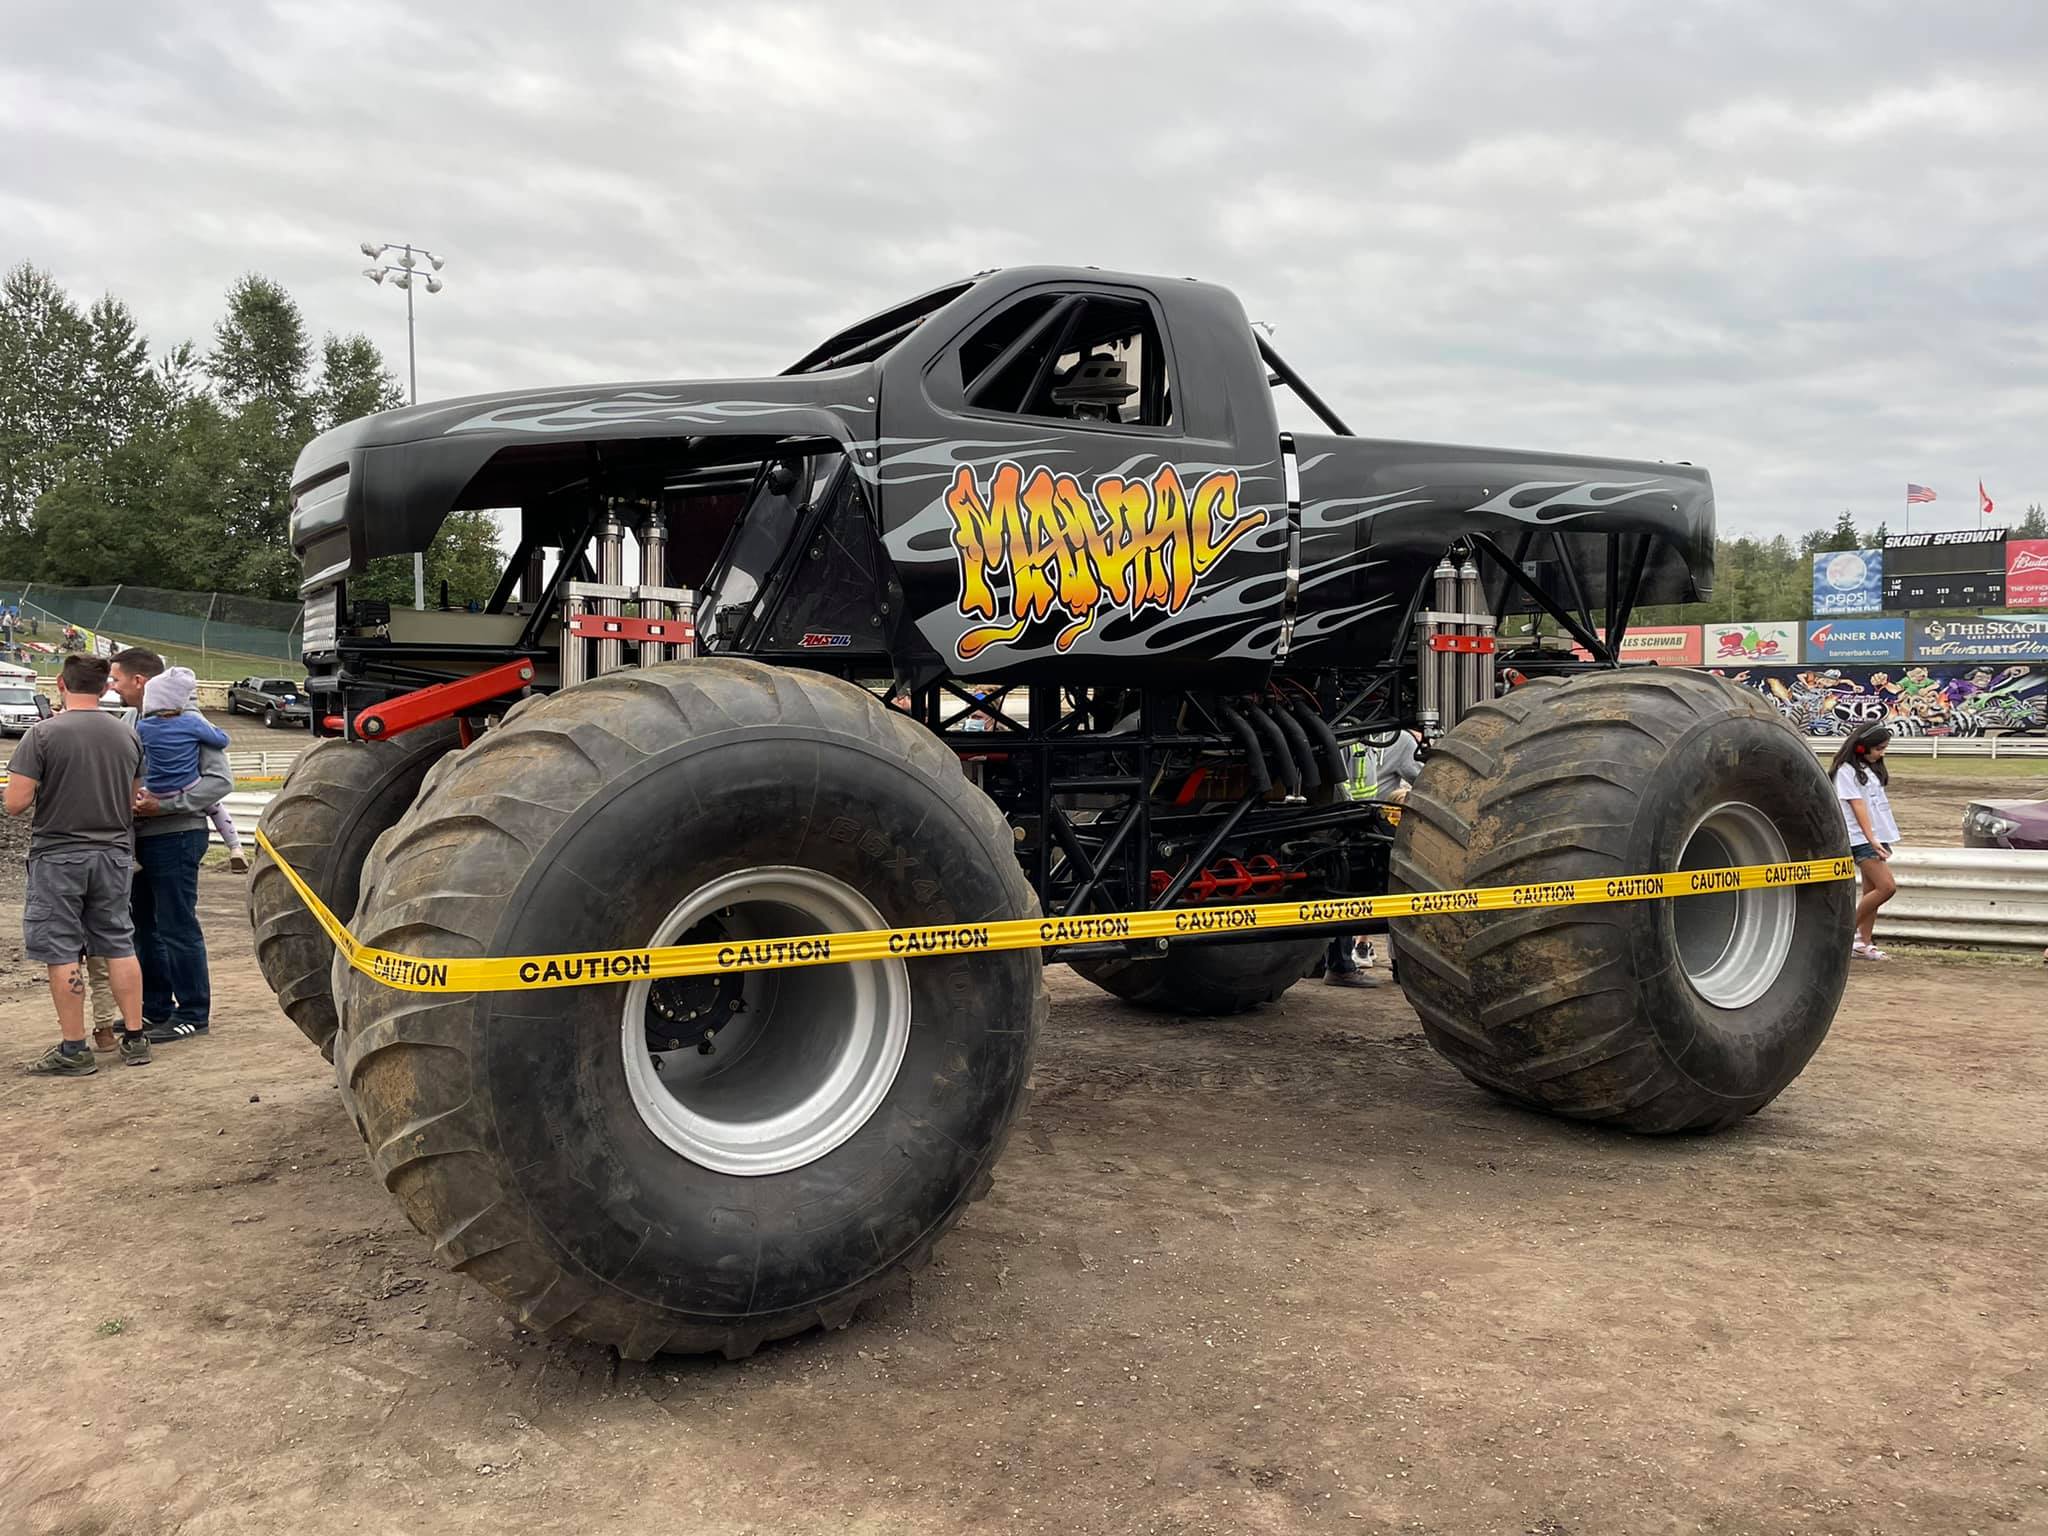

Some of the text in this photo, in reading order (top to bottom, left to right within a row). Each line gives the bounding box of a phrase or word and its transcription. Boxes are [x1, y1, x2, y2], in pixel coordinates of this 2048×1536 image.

[1884, 530, 2005, 548] SKAGIT SPEEDWAY
[944, 461, 1268, 661] MANIAC
[1826, 590, 1867, 606] pepsi
[1819, 630, 1902, 641] BANNER BANK
[1946, 623, 1985, 635] THE
[798, 633, 851, 648] AMSOIL
[1623, 637, 1682, 648] LES SCHWAB
[1829, 649, 1889, 657] bannerbank.com
[1919, 647, 1943, 656] THE
[1968, 645, 2017, 655] STARTS
[374, 955, 447, 986] CAUTION
[520, 955, 650, 983] CAUTION
[718, 940, 830, 967] CAUTION
[889, 928, 988, 952] CAUTION
[1040, 918, 1128, 941] CAUTION
[1176, 910, 1256, 930] CAUTION
[1300, 902, 1372, 920] CAUTION
[1412, 893, 1477, 911] CAUTION
[1514, 886, 1574, 904] CAUTION
[1608, 879, 1663, 896] CAUTION
[1692, 872, 1739, 889] CAUTION
[1766, 866, 1810, 882] CAUTION
